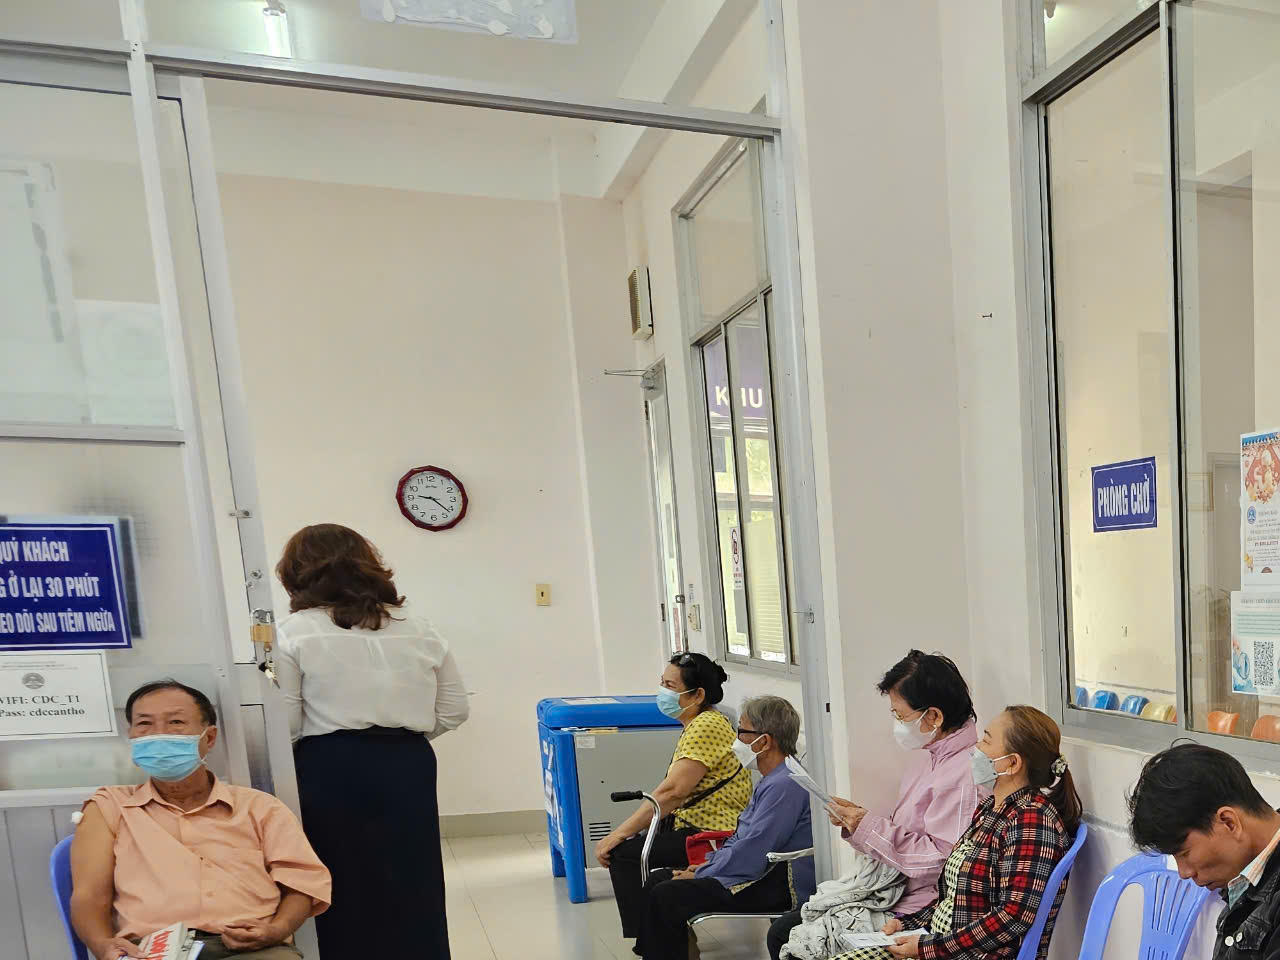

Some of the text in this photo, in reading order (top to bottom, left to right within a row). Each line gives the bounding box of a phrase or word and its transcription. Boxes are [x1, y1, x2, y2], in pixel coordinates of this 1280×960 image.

[1097, 473, 1150, 518] PHÒNG CHỜ
[22, 536, 70, 562] KHÁCH
[8, 569, 20, 598] Ở
[20, 576, 44, 602] LẠI
[45, 576, 64, 598] 30
[65, 572, 100, 598] PHÚT
[15, 608, 35, 633] DÕI
[36, 612, 58, 633] SAU
[58, 607, 85, 632] TIÊM
[85, 607, 116, 632] NGỪA
[29, 706, 85, 717] cdccantho
